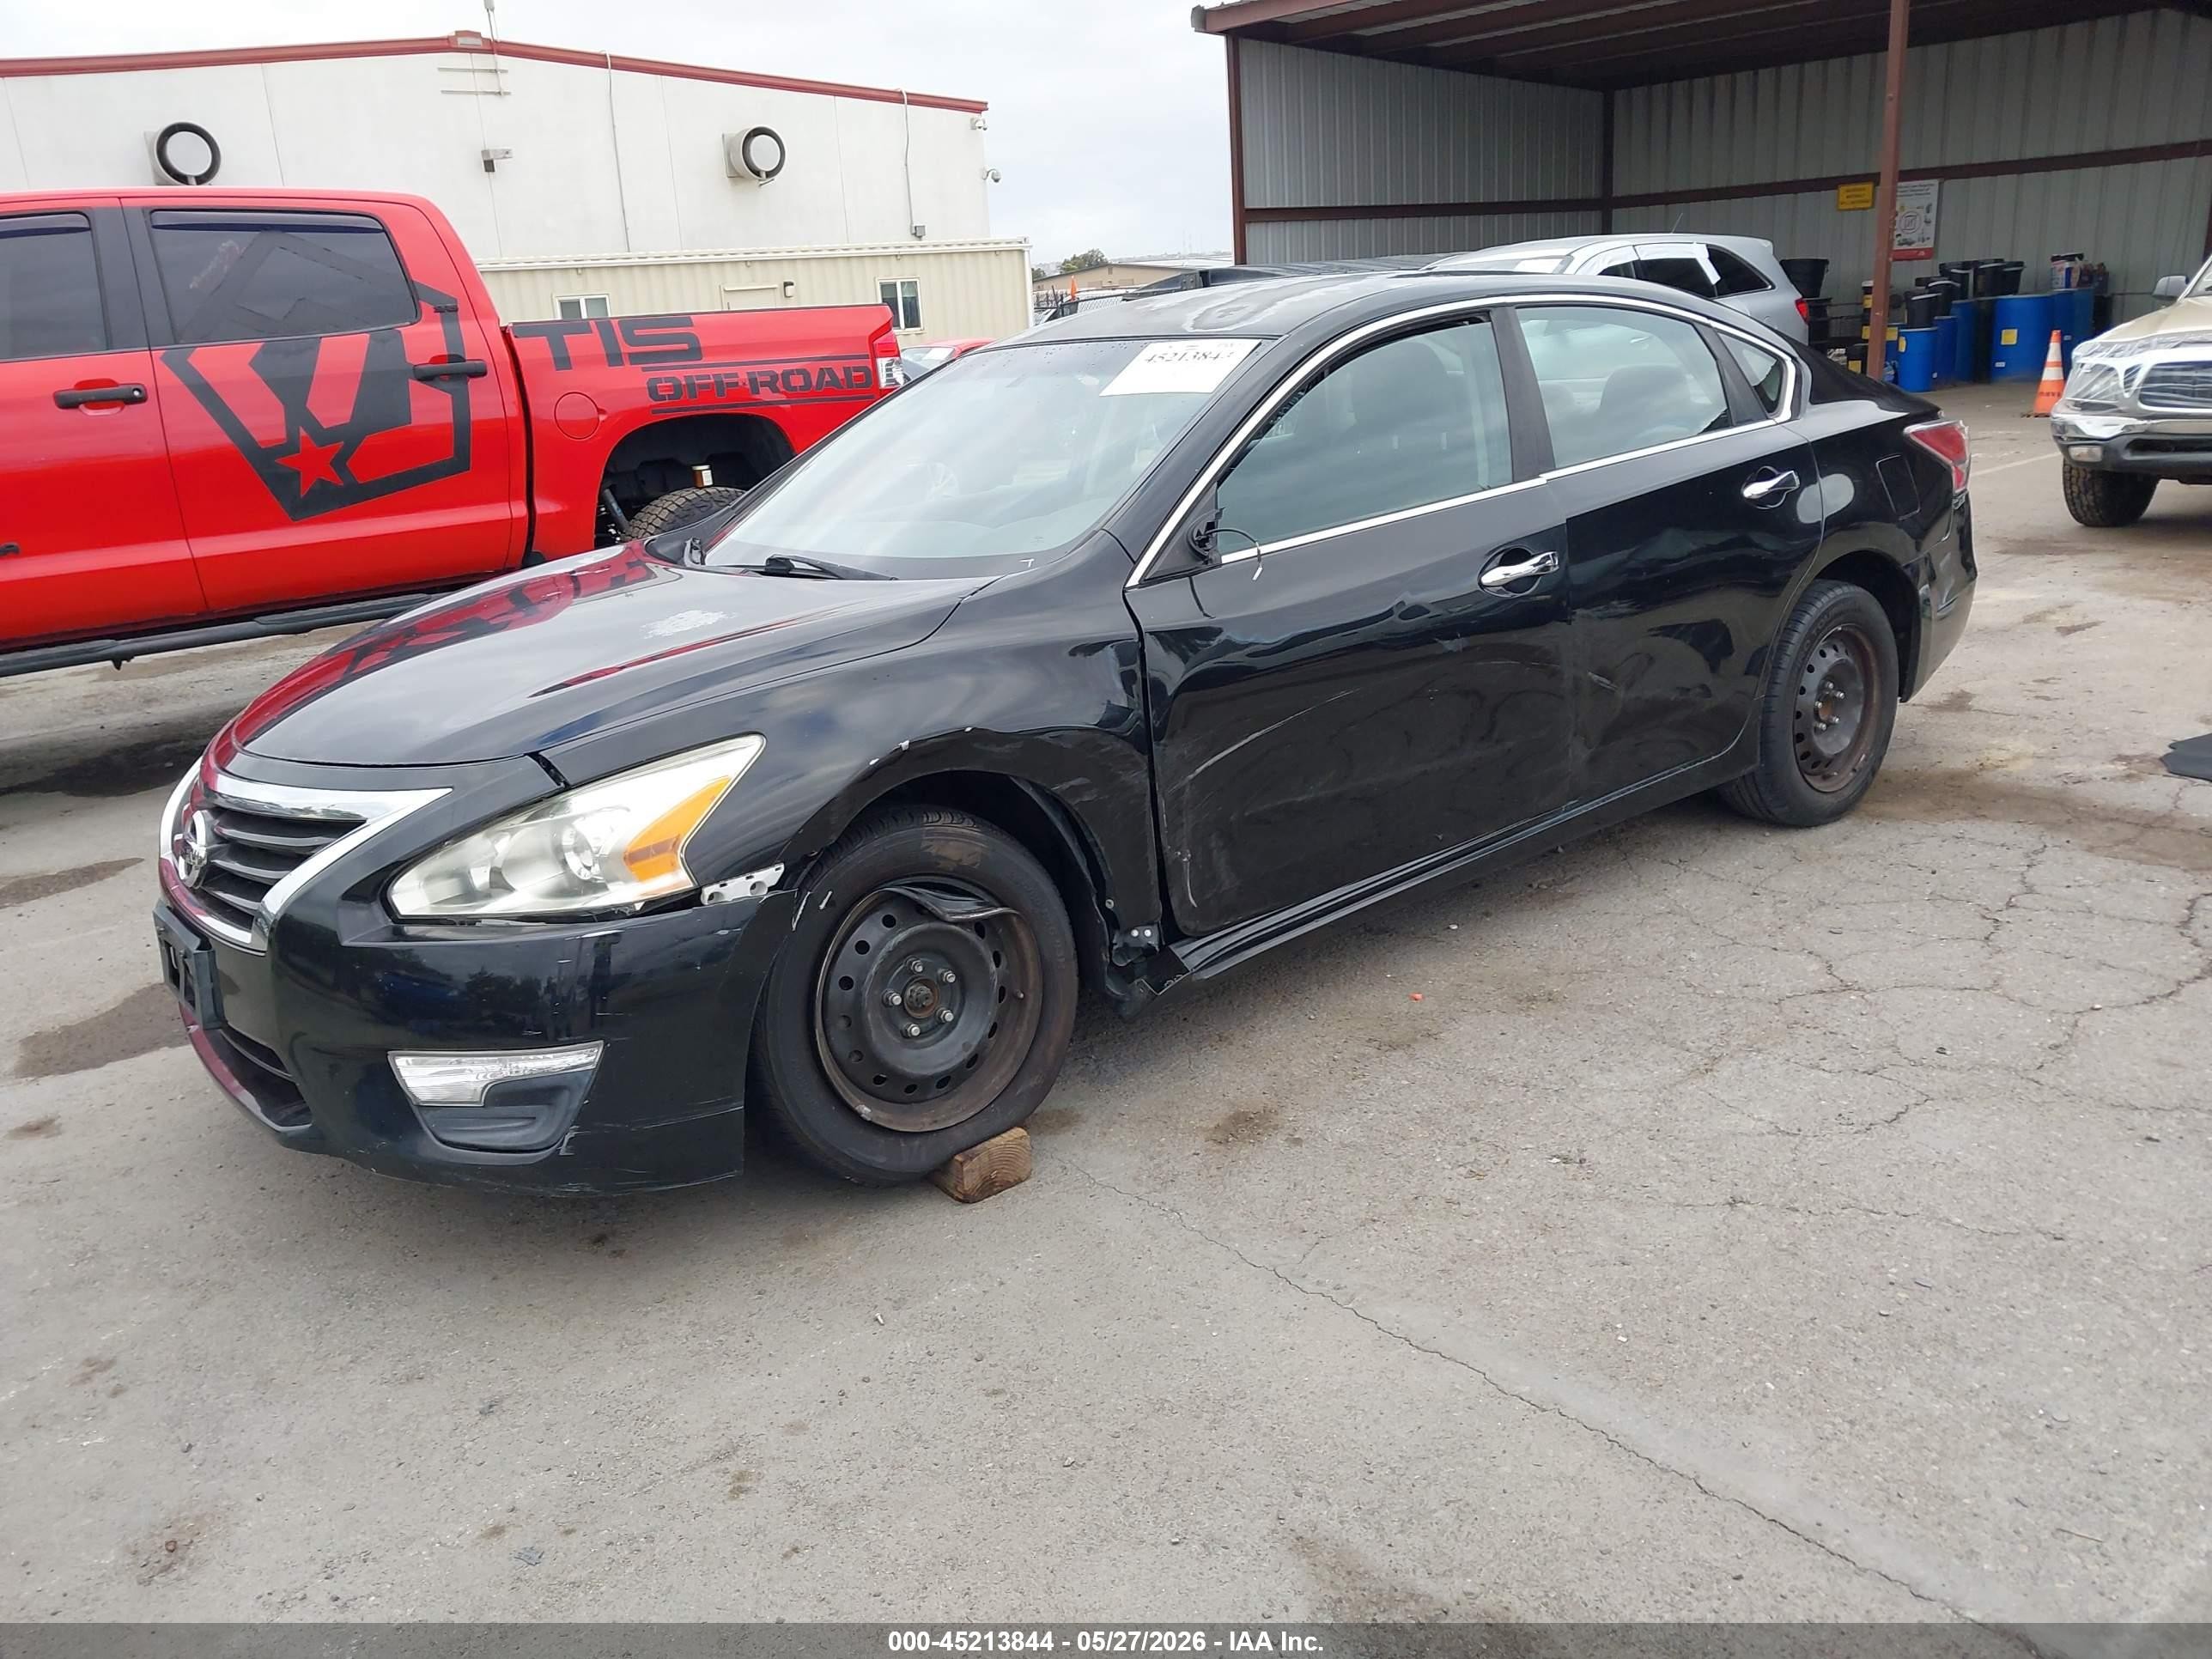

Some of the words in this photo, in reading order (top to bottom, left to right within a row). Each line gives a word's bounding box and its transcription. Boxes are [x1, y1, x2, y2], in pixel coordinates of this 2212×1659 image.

[513, 316, 703, 371] TIS
[646, 371, 739, 402] OFF
[746, 366, 873, 395] ROAD
